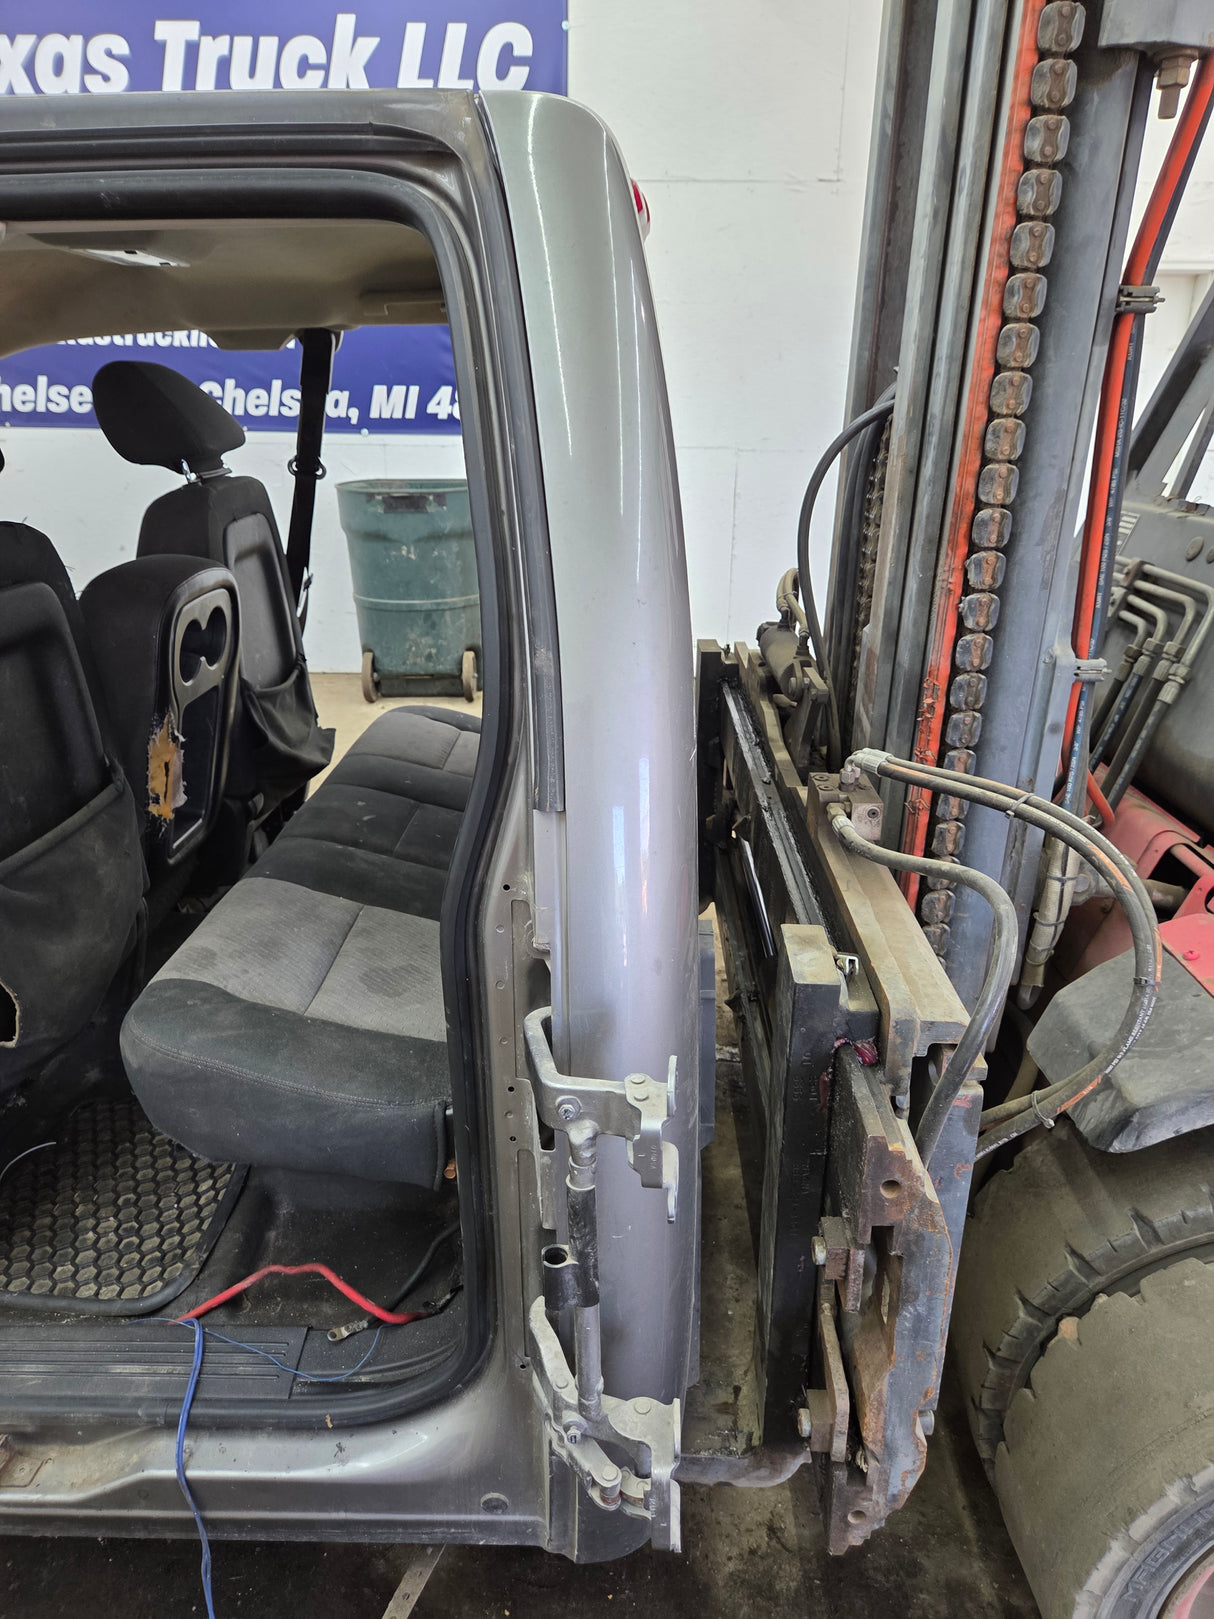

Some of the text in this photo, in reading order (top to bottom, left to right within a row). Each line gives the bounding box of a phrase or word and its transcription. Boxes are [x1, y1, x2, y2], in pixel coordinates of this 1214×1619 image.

[154, 13, 381, 92] Truck
[398, 22, 533, 91] LLC
[369, 385, 420, 419] MI
[426, 385, 461, 420] 4
